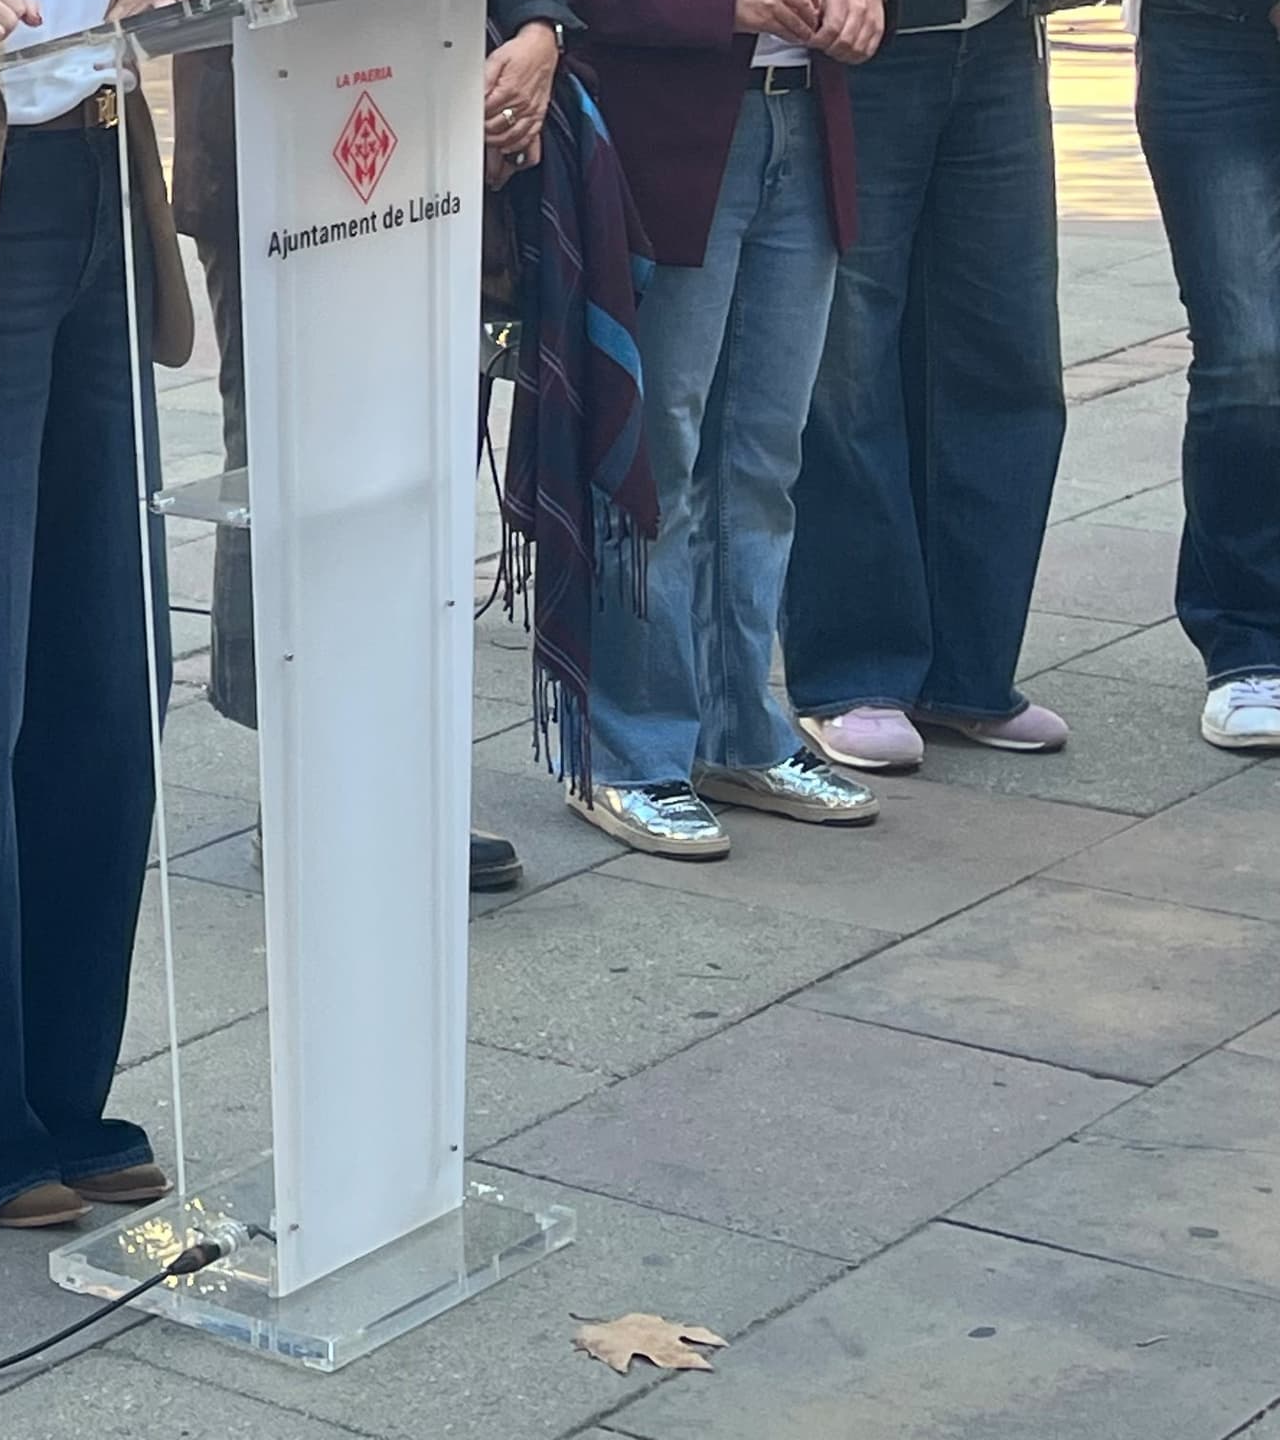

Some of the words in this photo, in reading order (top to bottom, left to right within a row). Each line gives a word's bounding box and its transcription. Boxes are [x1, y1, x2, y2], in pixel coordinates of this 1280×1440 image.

[336, 74, 350, 88] LA
[353, 66, 393, 86] PAERIA
[268, 211, 378, 260] Ajuntament
[383, 204, 404, 229] de
[409, 191, 461, 223] Lleida
